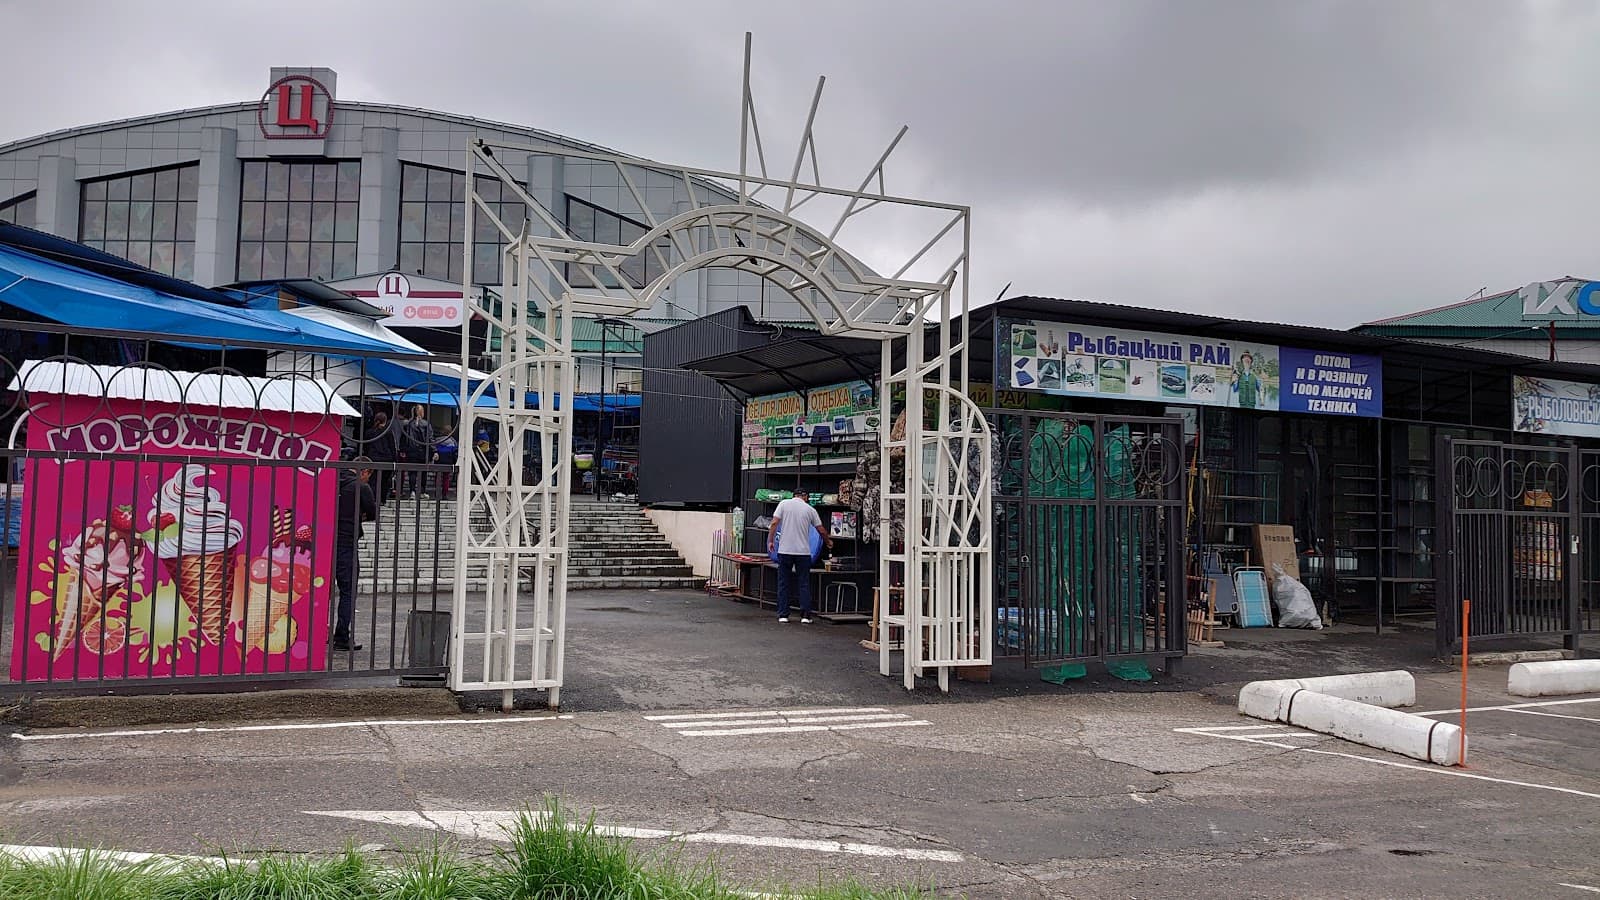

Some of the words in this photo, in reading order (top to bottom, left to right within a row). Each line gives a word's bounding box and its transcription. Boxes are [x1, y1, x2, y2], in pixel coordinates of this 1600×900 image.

[276, 85, 318, 134] Ц
[385, 276, 403, 298] Ц
[1067, 331, 1182, 361] Рыбацкий
[1189, 342, 1231, 366] РАЙ
[1313, 354, 1351, 369] ОПТОМ
[1296, 367, 1305, 380] И
[1307, 368, 1316, 381] В
[1318, 369, 1368, 386] РОЗНИЦУ
[1292, 382, 1320, 396] 1000
[1321, 385, 1373, 400] МЕЛОЧЕЙ
[777, 397, 801, 416] ДОМА
[811, 387, 850, 412] ОТДЫХА
[1307, 399, 1357, 414] ТЕХНИКА
